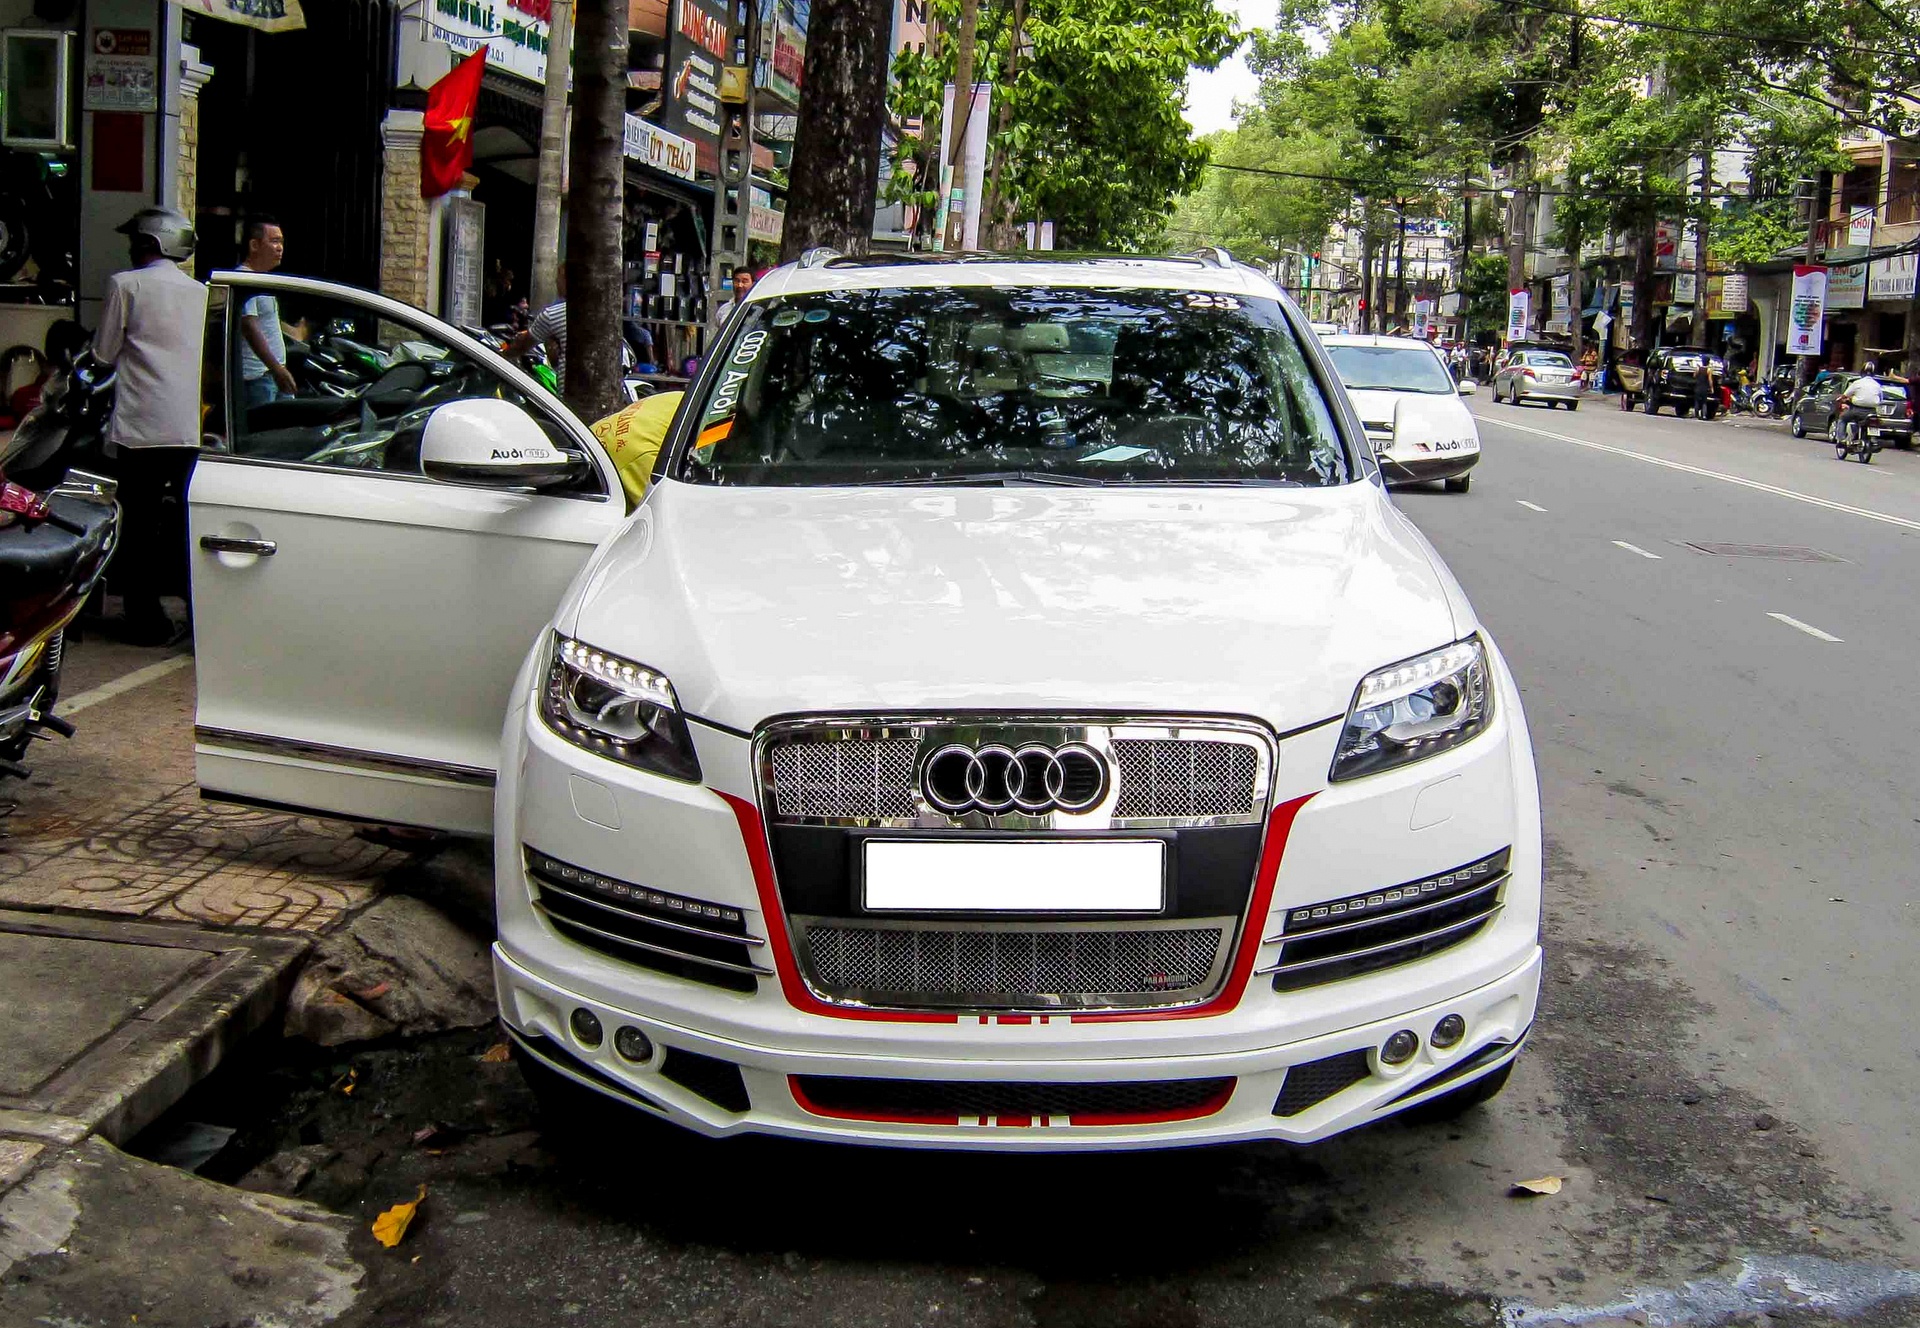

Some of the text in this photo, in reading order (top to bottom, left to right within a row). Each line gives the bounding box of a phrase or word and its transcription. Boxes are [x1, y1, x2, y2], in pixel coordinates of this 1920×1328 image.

[1186, 293, 1241, 310] 23
[709, 370, 749, 415] Audi
[1435, 441, 1460, 452] Audi
[490, 448, 523, 460] Audi
